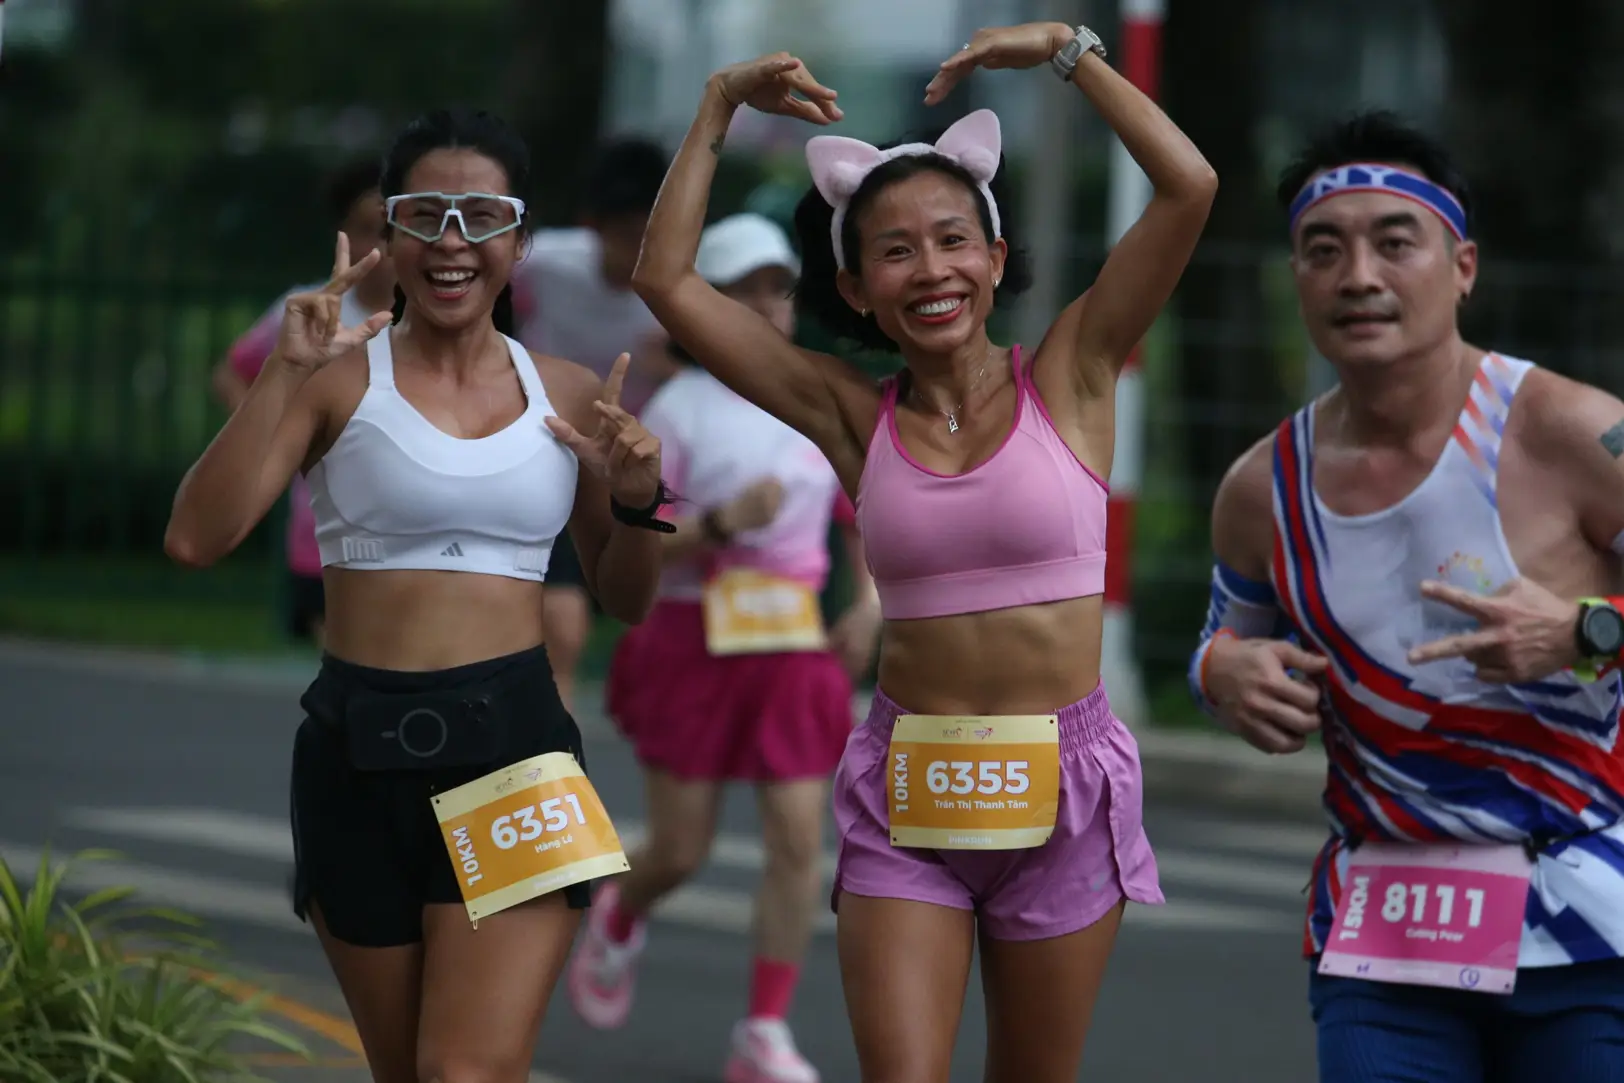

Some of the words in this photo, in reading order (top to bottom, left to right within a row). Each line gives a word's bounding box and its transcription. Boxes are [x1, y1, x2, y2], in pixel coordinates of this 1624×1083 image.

[895, 753, 909, 812] 10KM
[926, 760, 1030, 795] 6355
[974, 799, 1005, 809] Thanh
[491, 793, 586, 850] 6351
[452, 826, 484, 887] 10KM
[1339, 876, 1370, 941] 15KM
[1381, 882, 1485, 928] 8111
